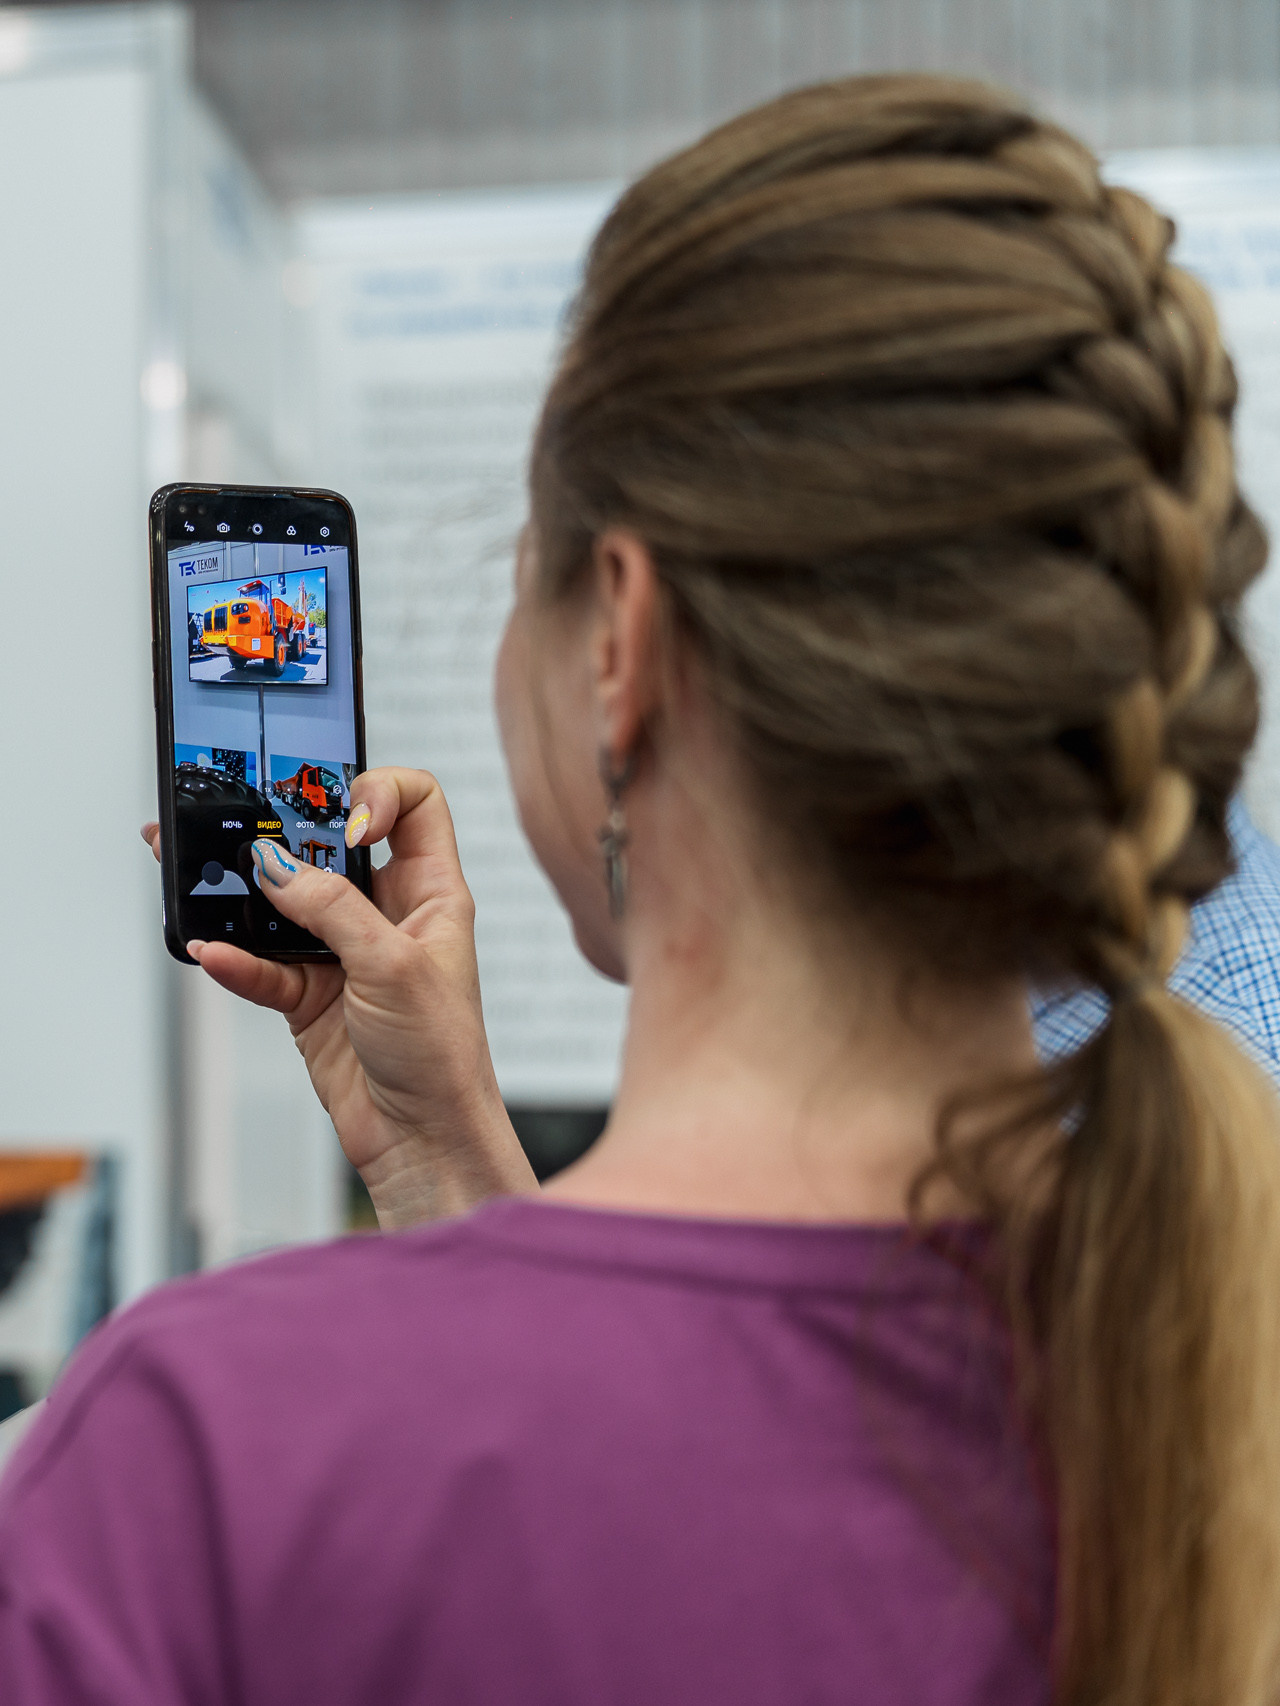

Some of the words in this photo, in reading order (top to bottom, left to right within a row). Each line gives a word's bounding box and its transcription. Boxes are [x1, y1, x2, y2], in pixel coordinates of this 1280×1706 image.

[222, 821, 243, 829] НОЧЬ
[257, 821, 282, 829] ВИДЕО
[296, 821, 315, 829] ФОТО
